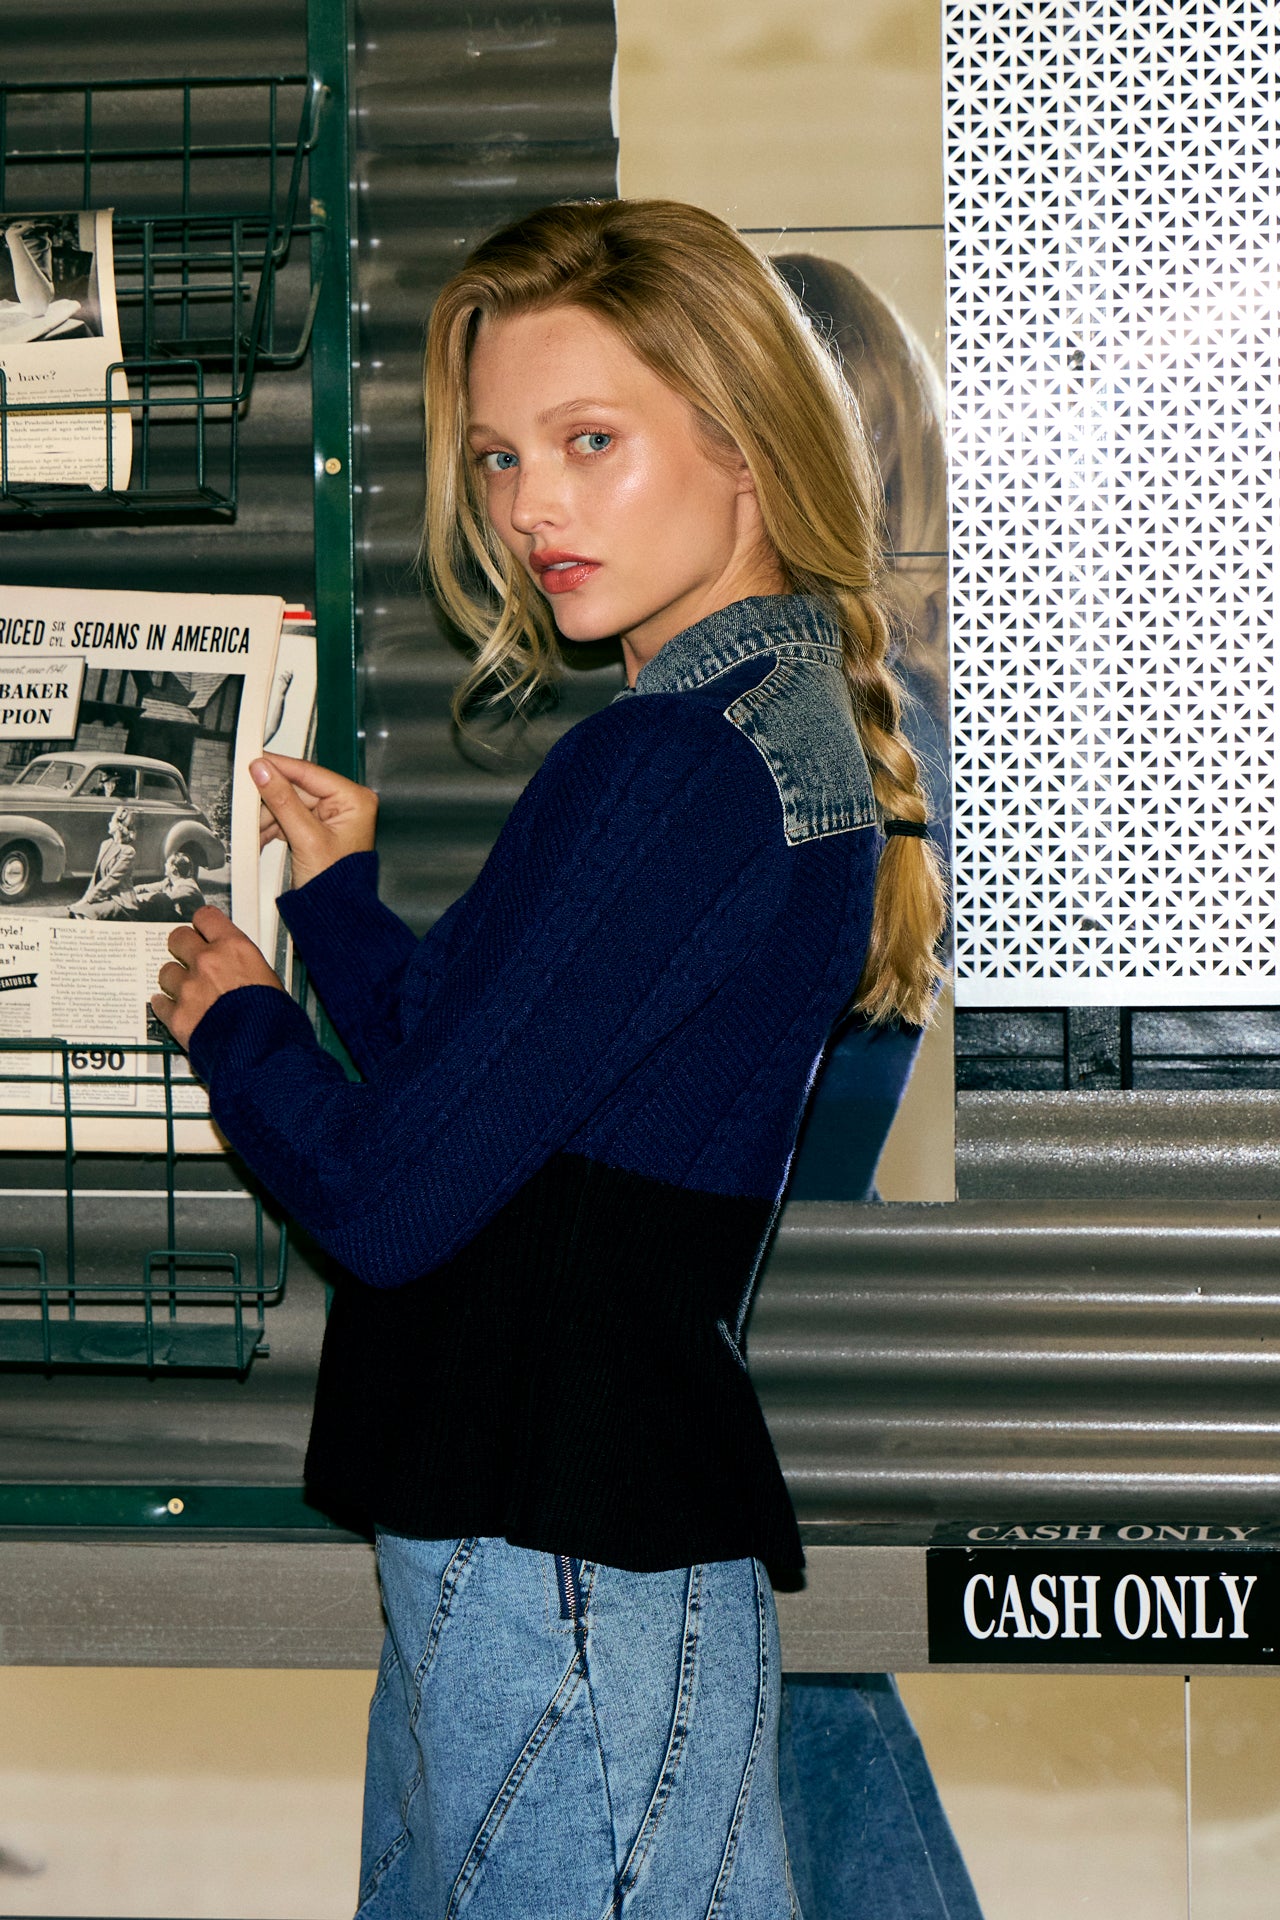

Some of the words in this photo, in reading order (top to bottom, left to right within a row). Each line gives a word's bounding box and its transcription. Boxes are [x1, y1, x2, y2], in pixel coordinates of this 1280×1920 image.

[18, 370, 56, 382] have?
[52, 620, 66, 632] SIX
[70, 621, 140, 650] SEDANS
[146, 624, 167, 651] IN
[172, 625, 250, 654] AMERICA
[0, 683, 69, 699] BAKER
[2, 708, 52, 725] PION
[9, 940, 40, 952] value!
[967, 1524, 1105, 1541] CASH
[1117, 1524, 1261, 1542] ONLY
[963, 1573, 1102, 1640] CASH
[1114, 1573, 1258, 1640] ONLY
